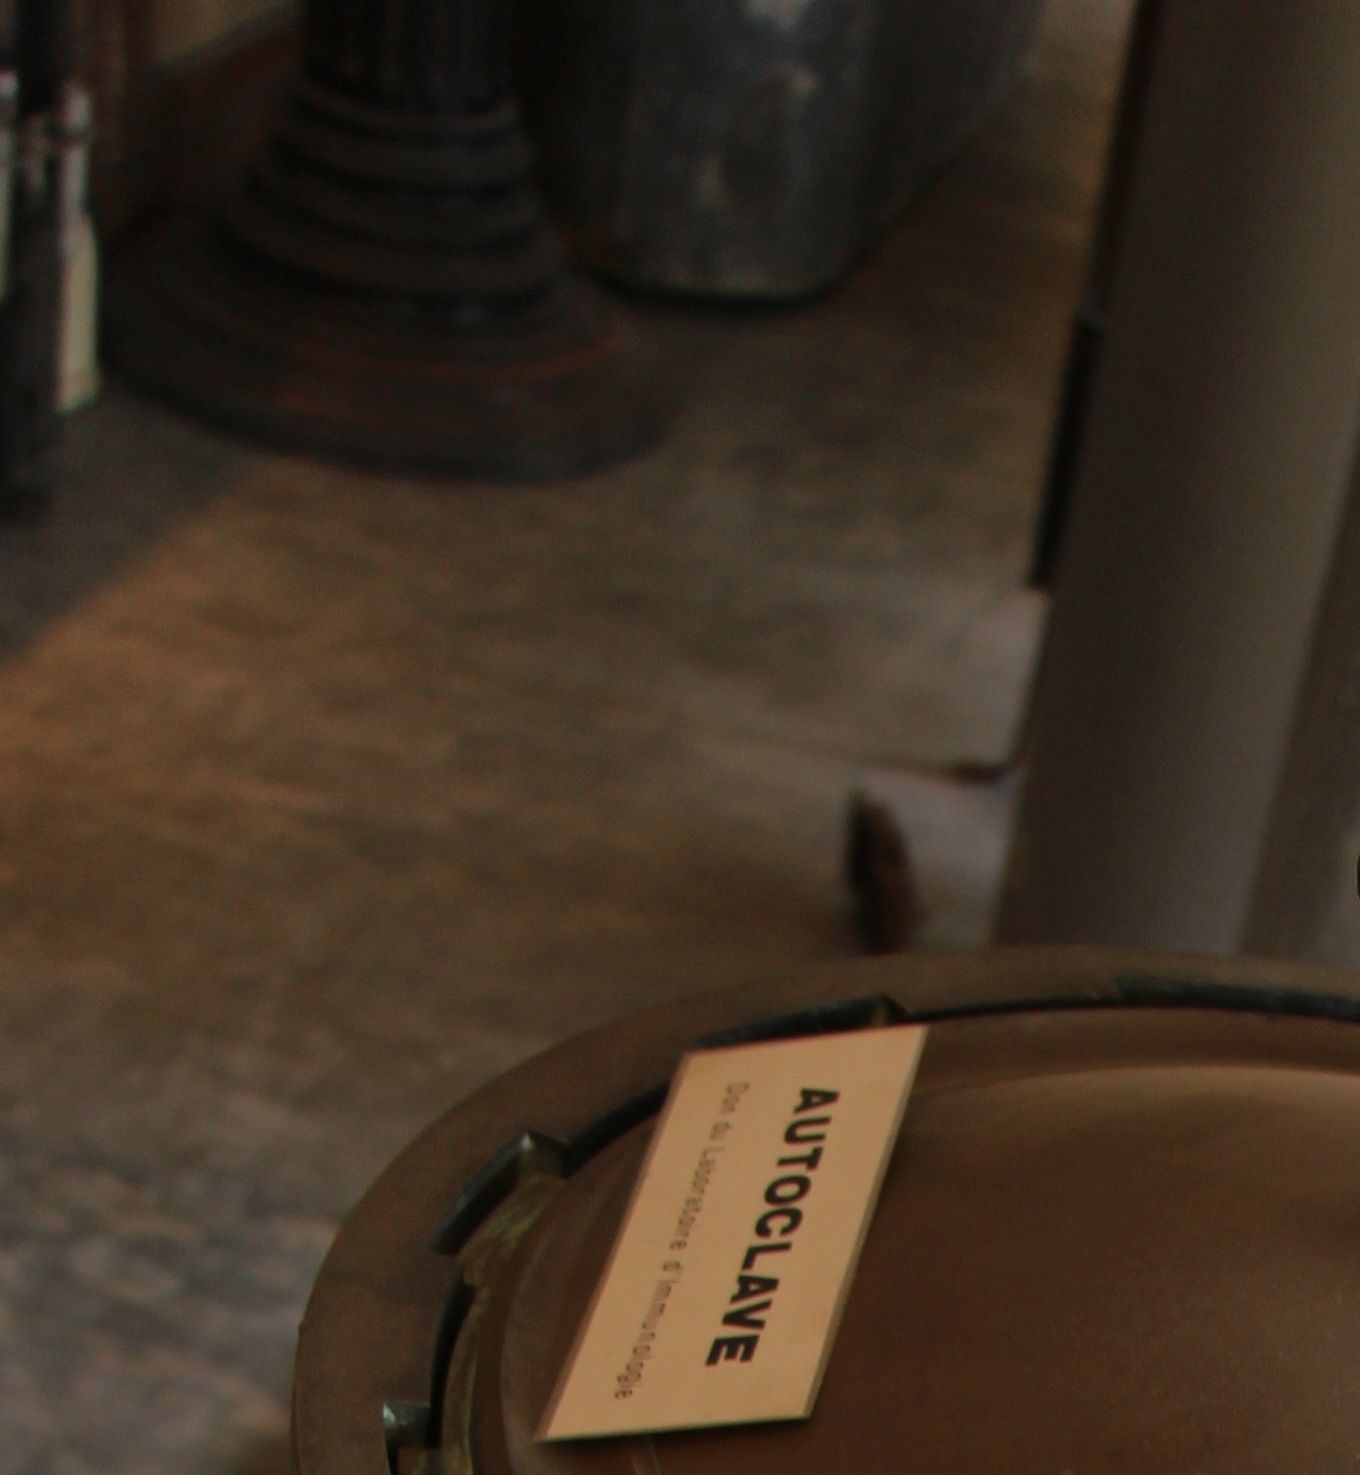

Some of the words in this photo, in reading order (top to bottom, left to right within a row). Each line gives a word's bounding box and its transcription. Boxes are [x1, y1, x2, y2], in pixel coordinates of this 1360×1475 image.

[709, 1121, 733, 1142] du
[725, 1080, 750, 1116] Don
[669, 1145, 726, 1251] Laboratoire
[705, 1087, 840, 1367] AUTOCLAVE
